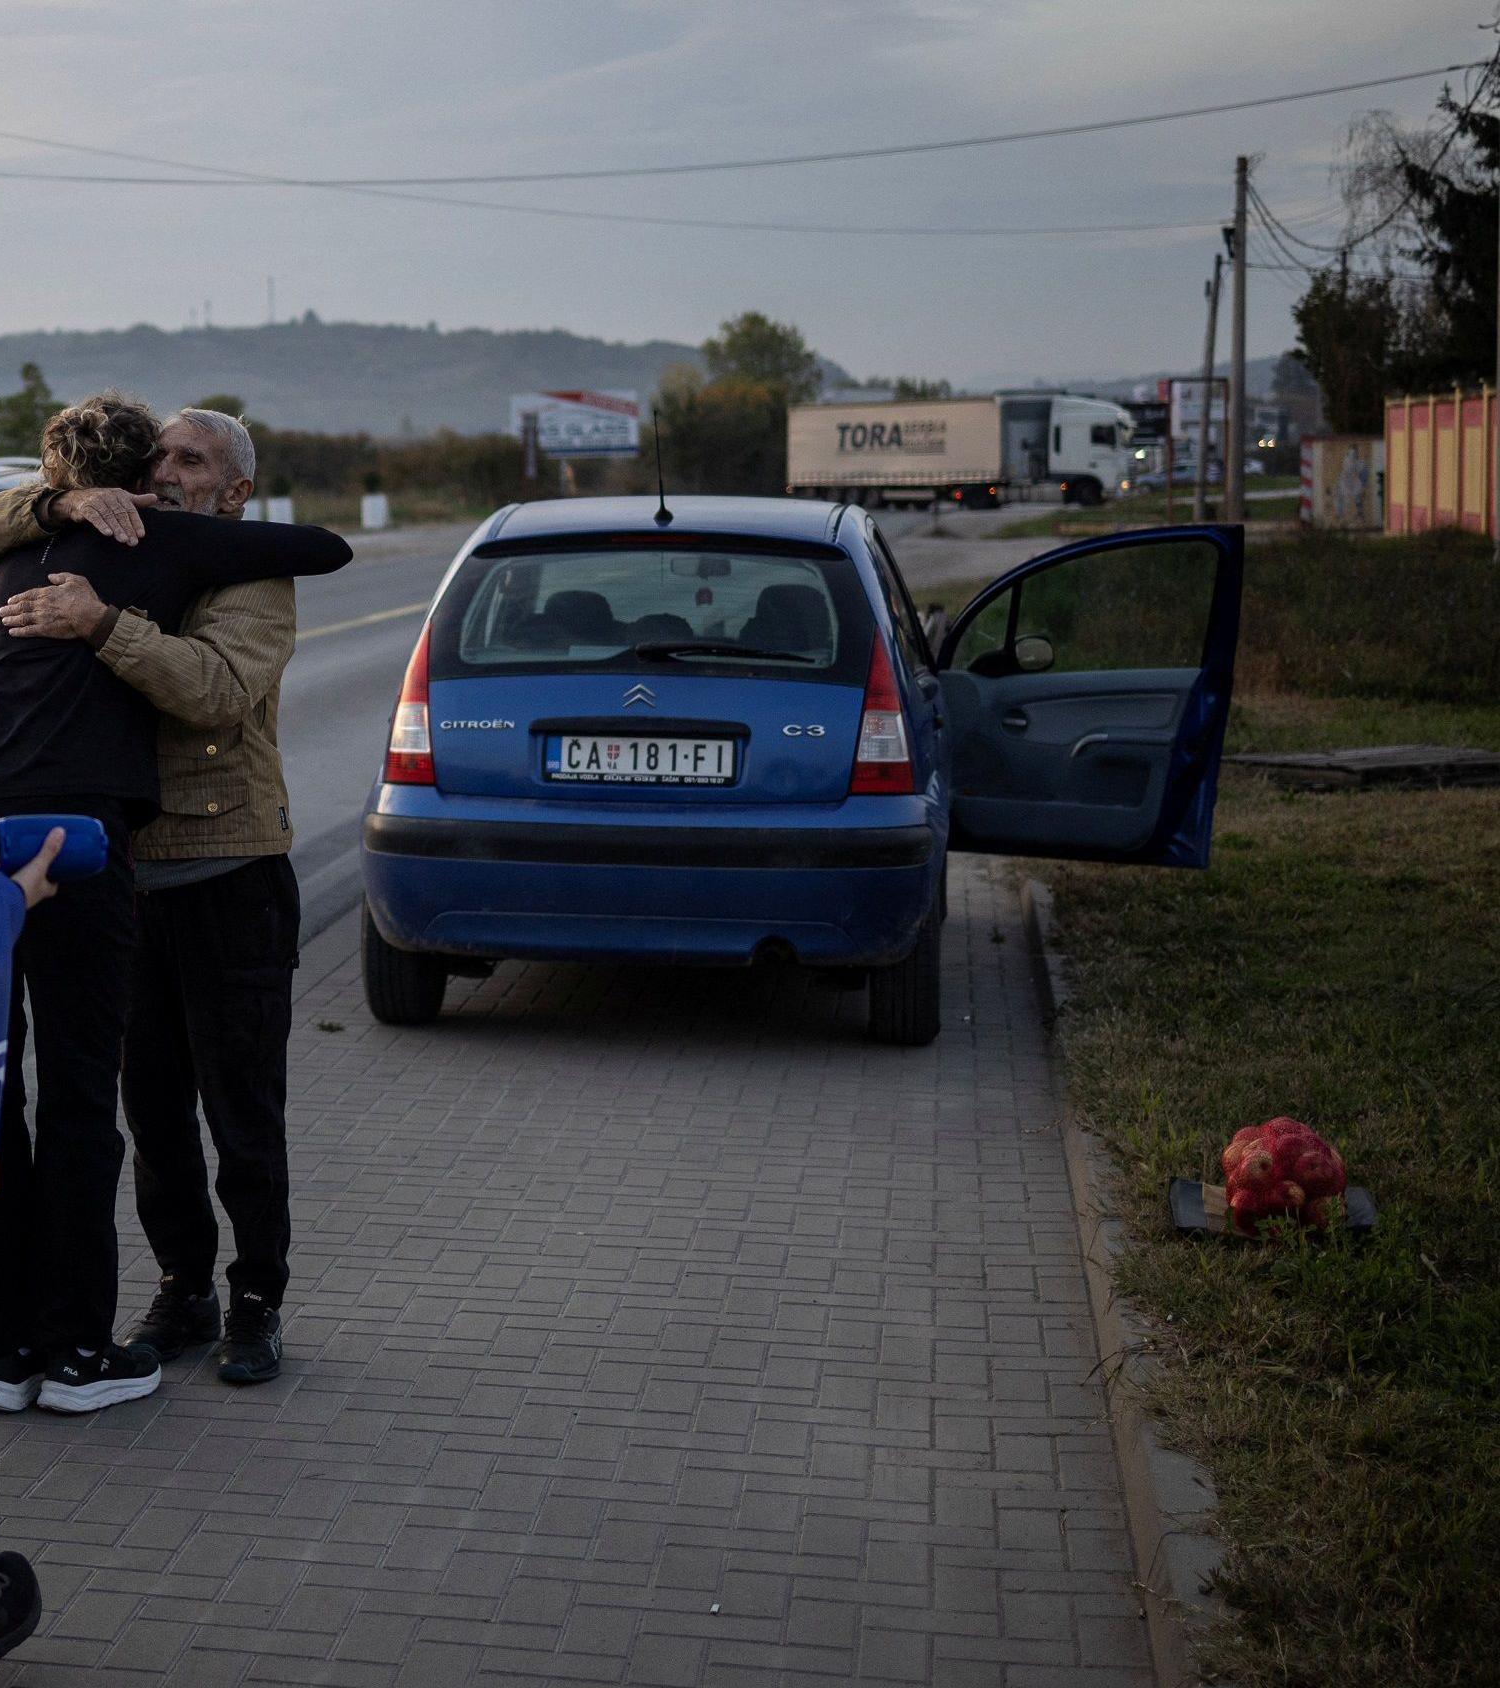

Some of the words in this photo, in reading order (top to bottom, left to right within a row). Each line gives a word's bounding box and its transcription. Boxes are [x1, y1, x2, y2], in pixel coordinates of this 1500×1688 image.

[836, 421, 902, 450] TORA
[440, 718, 515, 729] CITROËN
[782, 724, 825, 736] C3
[567, 739, 601, 770] ČA
[63, 1366, 78, 1377] FILA
